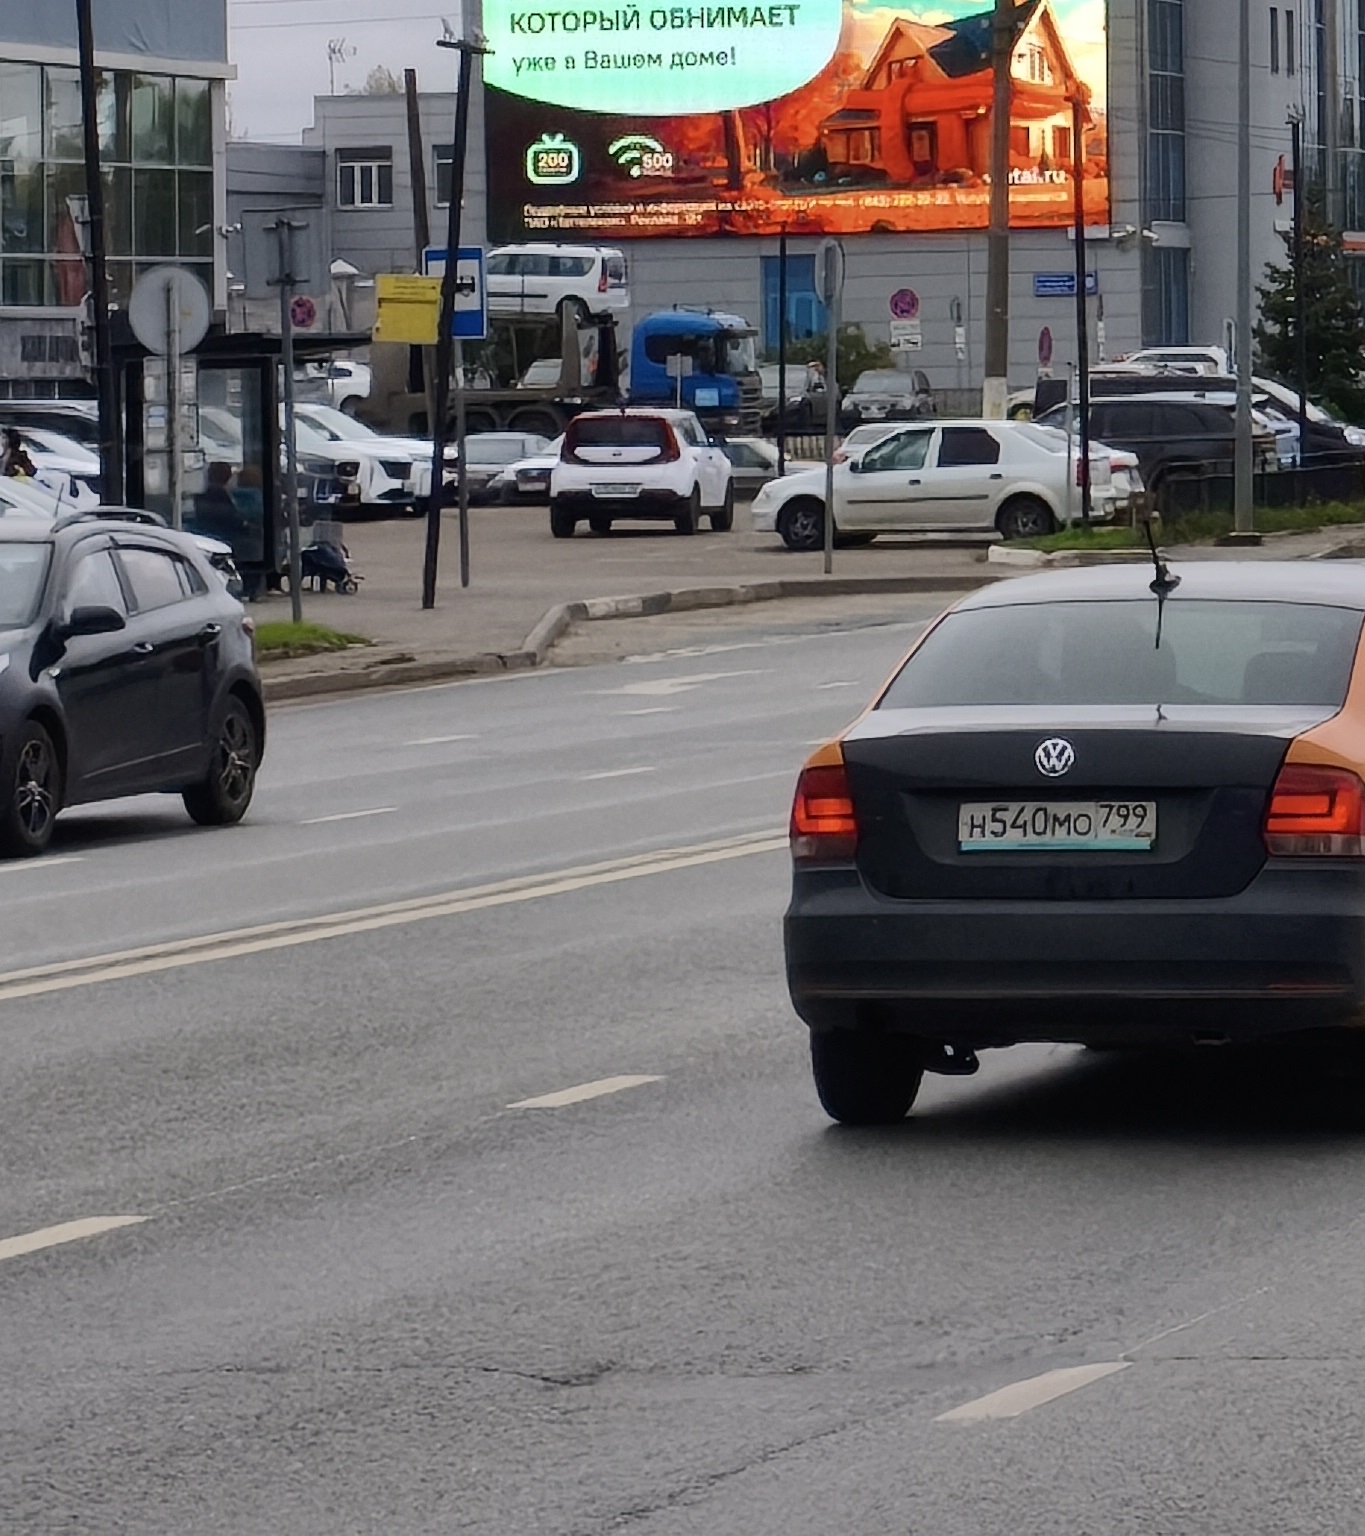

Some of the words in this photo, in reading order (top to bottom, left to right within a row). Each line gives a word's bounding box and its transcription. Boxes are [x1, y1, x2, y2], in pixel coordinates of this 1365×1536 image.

[509, 4, 641, 34] КОТОРЫЙ
[650, 4, 801, 31] ОБНИМАЕТ
[511, 56, 557, 77] уже
[584, 50, 663, 70] Вашем
[669, 46, 737, 71] доме!
[538, 153, 570, 168] 200
